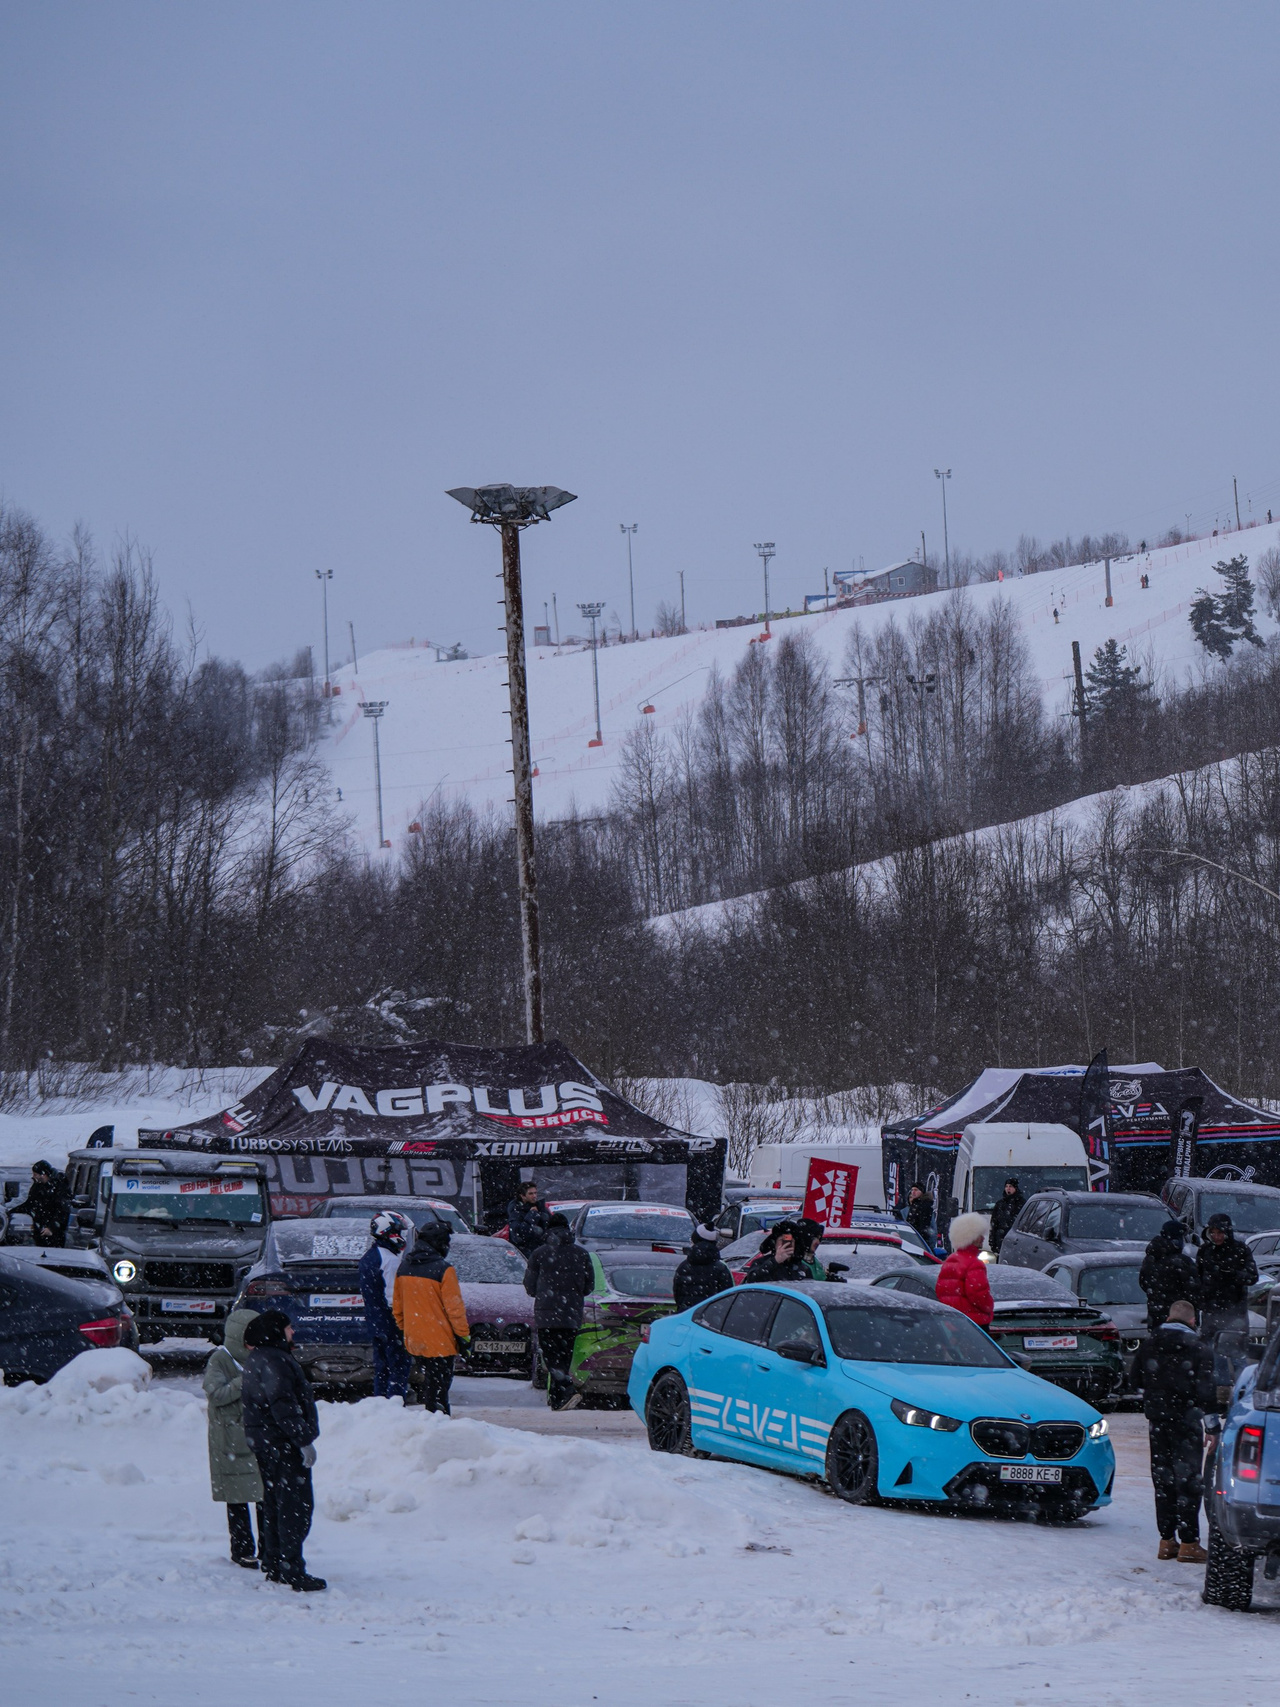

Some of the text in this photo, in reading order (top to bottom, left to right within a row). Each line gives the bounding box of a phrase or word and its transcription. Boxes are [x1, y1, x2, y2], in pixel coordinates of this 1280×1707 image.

[292, 1081, 603, 1117] VAGPLUS
[521, 1110, 604, 1127] SERVICE
[229, 1137, 353, 1152] TURBOSYSTEMS
[474, 1141, 561, 1156] XENUM
[1175, 1138, 1184, 1165] СЕРВИС
[1184, 1141, 1192, 1166] ALPINA
[180, 1182, 197, 1194] NEED
[197, 1180, 209, 1190] FOR
[224, 1180, 244, 1193] CLIMB
[829, 1169, 849, 1229] СТРИМ
[722, 1397, 800, 1451] LEVEL
[1010, 1467, 1060, 1480] 8888 KE-8
